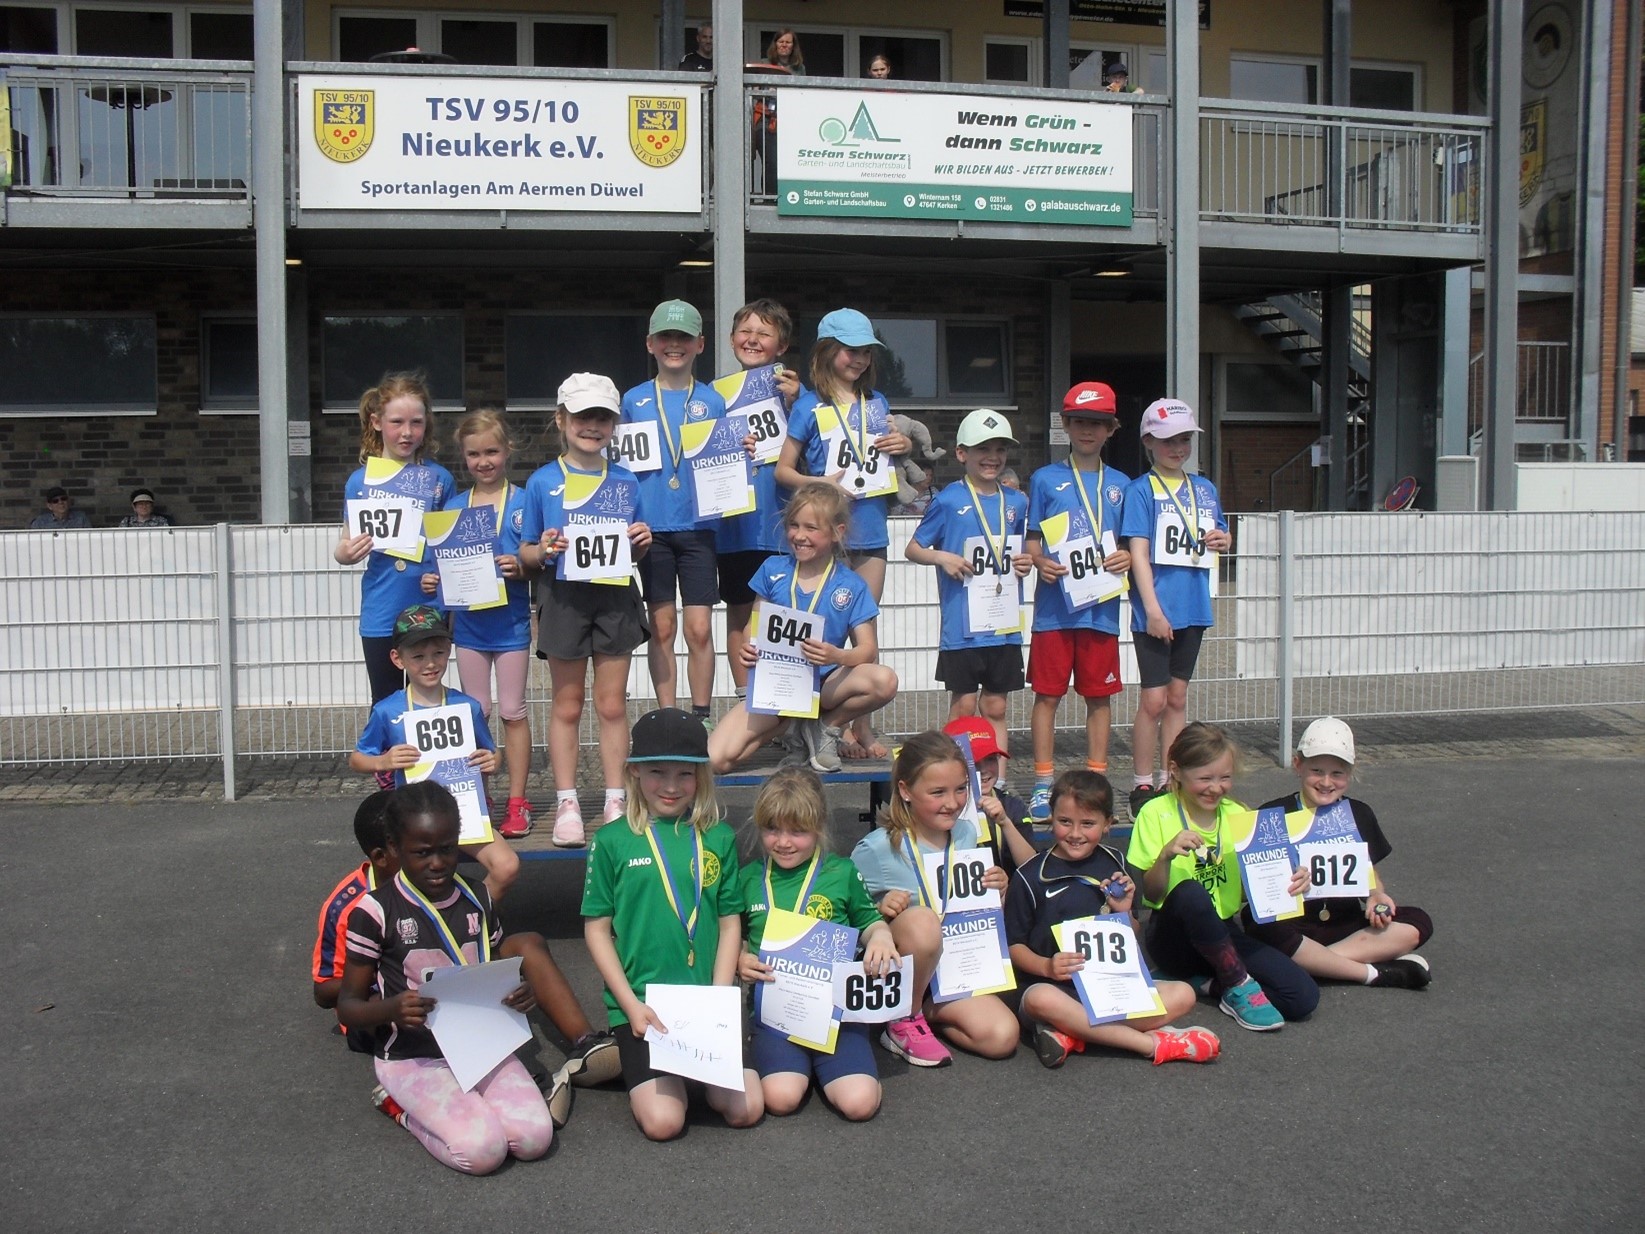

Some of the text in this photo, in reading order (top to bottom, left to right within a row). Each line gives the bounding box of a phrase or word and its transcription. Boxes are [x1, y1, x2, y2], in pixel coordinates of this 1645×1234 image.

[320, 93, 369, 103] TSV 95/10
[634, 100, 681, 110] TSV 95/10
[426, 98, 579, 125] TSV 95/10
[957, 111, 1017, 128] Wenn
[1025, 114, 1077, 130] Grün
[402, 132, 605, 160] Nieukerk e.V.
[945, 134, 1103, 155] dann Schwarz
[797, 149, 907, 161] Stefan Schwarz
[797, 159, 827, 167] Garten-
[829, 160, 845, 168] und
[846, 160, 906, 170] Landschaftsbau
[934, 164, 954, 175] WIR
[956, 164, 992, 175] BILDEN
[994, 165, 1014, 175] AUS
[1022, 165, 1053, 176] JETZT
[1054, 165, 1107, 176] BEWERBEN
[361, 180, 644, 200] Sportanlagen Am Aermen Düwel
[824, 190, 850, 198] Schwarz
[840, 199, 887, 207] Landschaftsbau
[1040, 201, 1121, 212] galabauschwarz.de
[750, 410, 780, 442] 38
[607, 431, 650, 464] 640
[837, 438, 880, 475] 63
[692, 451, 746, 470] URKUNDE
[368, 488, 426, 511] URKDE
[1160, 503, 1213, 519] URUDE
[358, 508, 403, 539] 637
[434, 542, 494, 559] URKUNDE
[575, 534, 620, 569] 647
[767, 614, 813, 647] 644
[415, 715, 464, 752] 639
[628, 857, 652, 867] JAKO
[1241, 847, 1289, 865] URKUNDE
[1310, 854, 1358, 887] 612
[466, 912, 480, 937] N
[941, 917, 997, 937] RKUNDE
[1074, 930, 1127, 964] 613
[765, 955, 833, 982] URKUND
[845, 971, 902, 1011] 653
